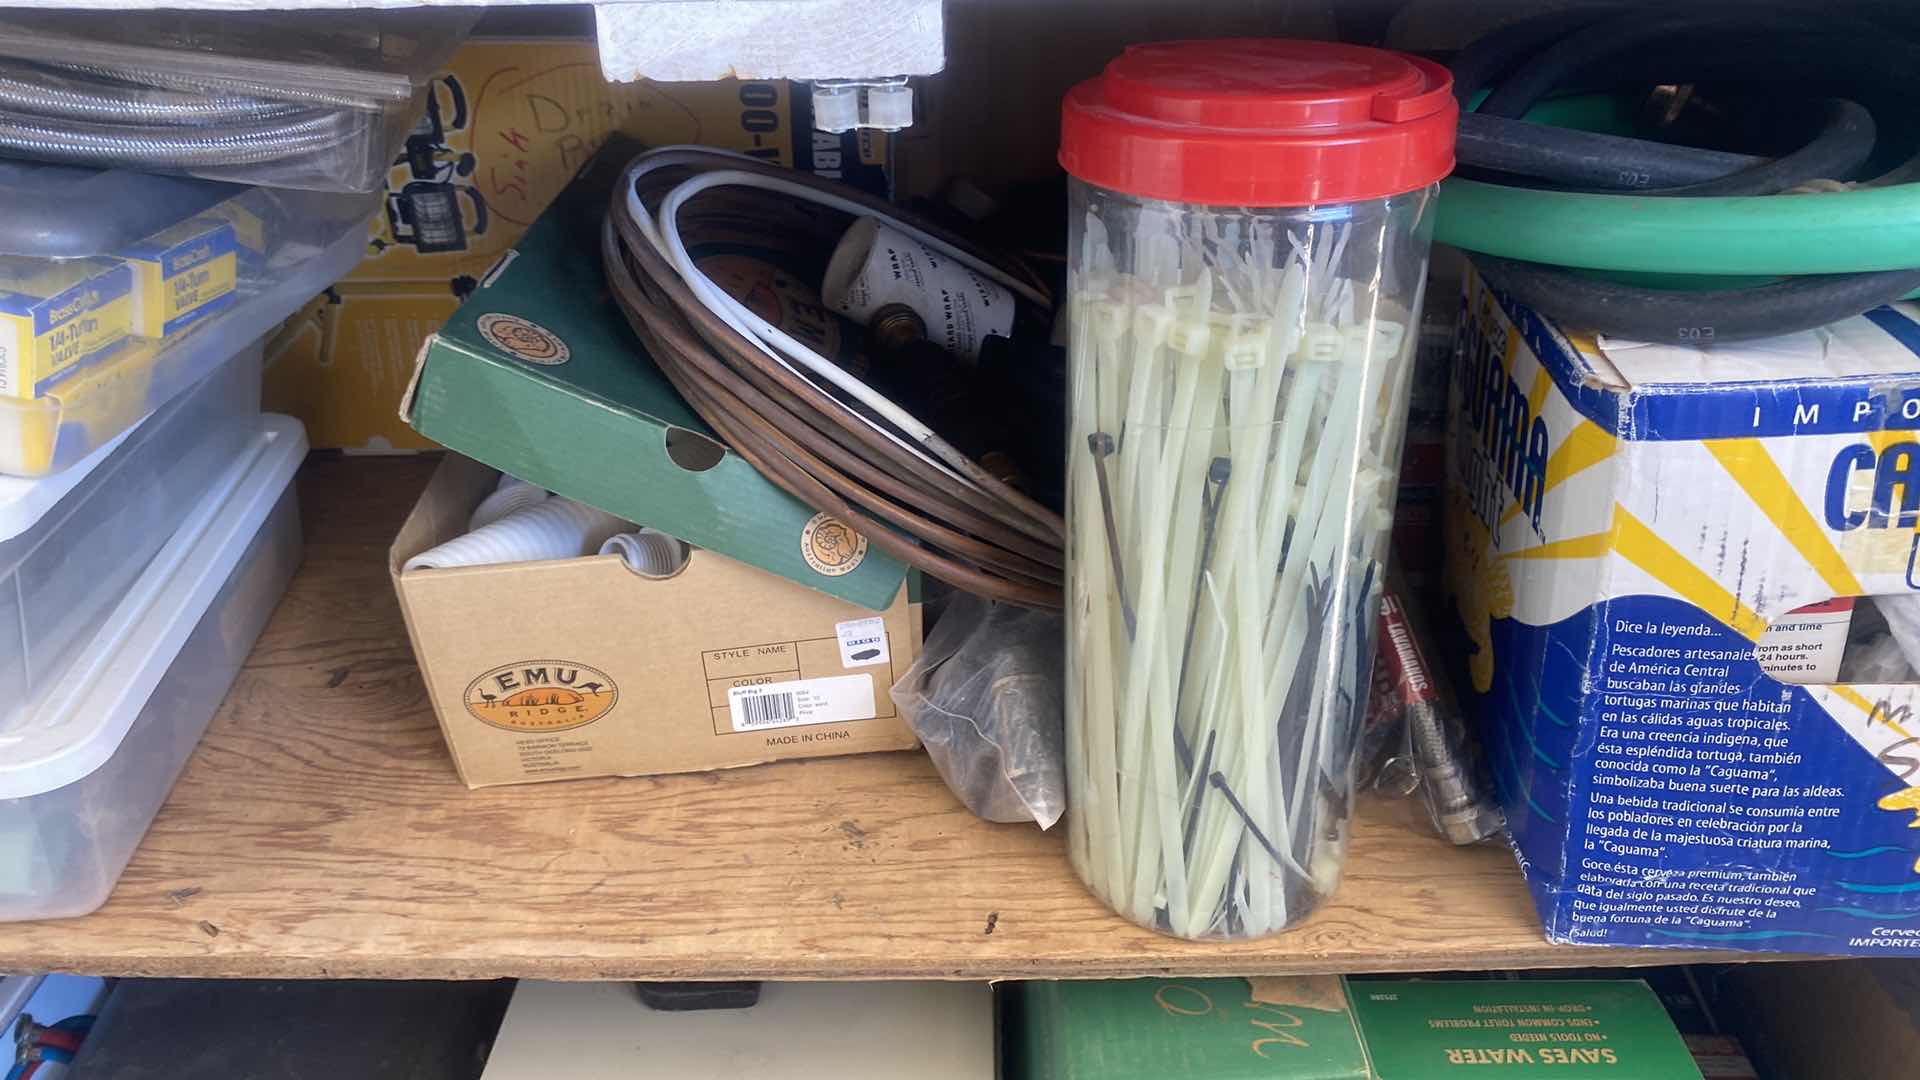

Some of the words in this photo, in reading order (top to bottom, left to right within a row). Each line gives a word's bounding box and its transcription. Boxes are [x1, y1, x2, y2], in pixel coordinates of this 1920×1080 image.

[1615, 620, 1643, 634] Dice
[1645, 621, 1658, 634] la
[1660, 622, 1722, 638] leyenda...
[1775, 624, 1796, 632] and
[1799, 623, 1823, 631] time
[713, 649, 750, 661] STYLE
[757, 645, 787, 655] NAME
[1612, 643, 1681, 659] Pescadores
[1795, 643, 1823, 651] short
[1387, 622, 1428, 693] LAVAMANOS
[1609, 661, 1626, 673] de
[1628, 662, 1681, 676] América
[1684, 664, 1730, 678] Central
[1806, 663, 1817, 671] to
[495, 667, 579, 691] EMU
[733, 676, 773, 688] COLOR
[1607, 676, 1666, 692] buscaban
[1669, 680, 1686, 693] las
[1690, 681, 1741, 696] grandes
[509, 706, 586, 718] RIDGE
[1604, 695, 1657, 710] tortugas
[1660, 696, 1711, 711] marinas
[1714, 701, 1739, 713] que
[1742, 699, 1792, 714] habitan
[1602, 712, 1618, 722] en
[1620, 711, 1638, 724] las
[1640, 712, 1683, 726] cálidas
[1686, 717, 1724, 730] aguas
[766, 735, 799, 746] MADE
[801, 733, 813, 742] IN
[816, 730, 850, 741] CHINA
[1600, 726, 1619, 739] Era
[1622, 730, 1646, 740] una
[1648, 731, 1700, 744] creencia
[1764, 738, 1789, 750] que
[1597, 742, 1623, 755] ésta
[1626, 745, 1693, 760] espléndida
[1696, 750, 1746, 764] tortuga,
[1749, 752, 1802, 765] también
[1594, 759, 1649, 772] conocida
[1652, 764, 1687, 776] como
[1689, 764, 1701, 776] la
[1592, 774, 1665, 790] simbolizaba
[1668, 779, 1707, 793] buena
[1710, 784, 1750, 796] suerte
[1752, 787, 1780, 798] para
[1782, 785, 1800, 797] las
[1802, 784, 1845, 798] aldeas.
[1590, 792, 1614, 805] Una
[1617, 794, 1659, 809] bebida
[1662, 800, 1727, 814] tradicional
[1729, 805, 1744, 816] se
[1807, 807, 1840, 818] entre
[1588, 807, 1605, 820] los
[1608, 810, 1674, 827] pobladores
[1677, 817, 1692, 828] en
[1696, 818, 1766, 833] celebración
[1768, 824, 1789, 836] por
[1791, 822, 1803, 833] la
[1584, 838, 1595, 850] la
[1586, 823, 1630, 839] llegada
[1632, 827, 1648, 840] de
[1651, 829, 1662, 841] la
[1665, 832, 1734, 847] majestuosa
[1736, 837, 1783, 849] criatura
[1582, 857, 1610, 872] Goce
[1613, 862, 1638, 875] ésta
[1748, 869, 1797, 882] también
[1664, 878, 1686, 889] una
[1688, 882, 1727, 891] receta
[1728, 883, 1790, 895] tradicional
[1793, 887, 1816, 897] que
[1605, 889, 1624, 900] del
[1626, 891, 1654, 902] siglo
[1702, 893, 1714, 903] Es
[1717, 896, 1762, 906] nuestro
[1574, 899, 1597, 911] que
[1599, 902, 1664, 913] igualmente
[1666, 905, 1699, 914] usted
[1748, 908, 1764, 918] de
[1766, 909, 1777, 919] la
[1572, 911, 1607, 924] buena
[1610, 914, 1652, 924] fortuna
[1654, 915, 1669, 924] de
[1671, 916, 1682, 925] la
[1428, 1019, 1481, 1029] PROBLEMS
[1484, 1019, 1516, 1028] TOILET
[1518, 1019, 1566, 1028] COMMON
[1509, 1033, 1548, 1042] NEEDED
[1551, 1033, 1583, 1042] TOOLS
[1584, 1033, 1601, 1042] NO
[1445, 1048, 1535, 1065] WATER
[1539, 1048, 1617, 1065] SAVES
